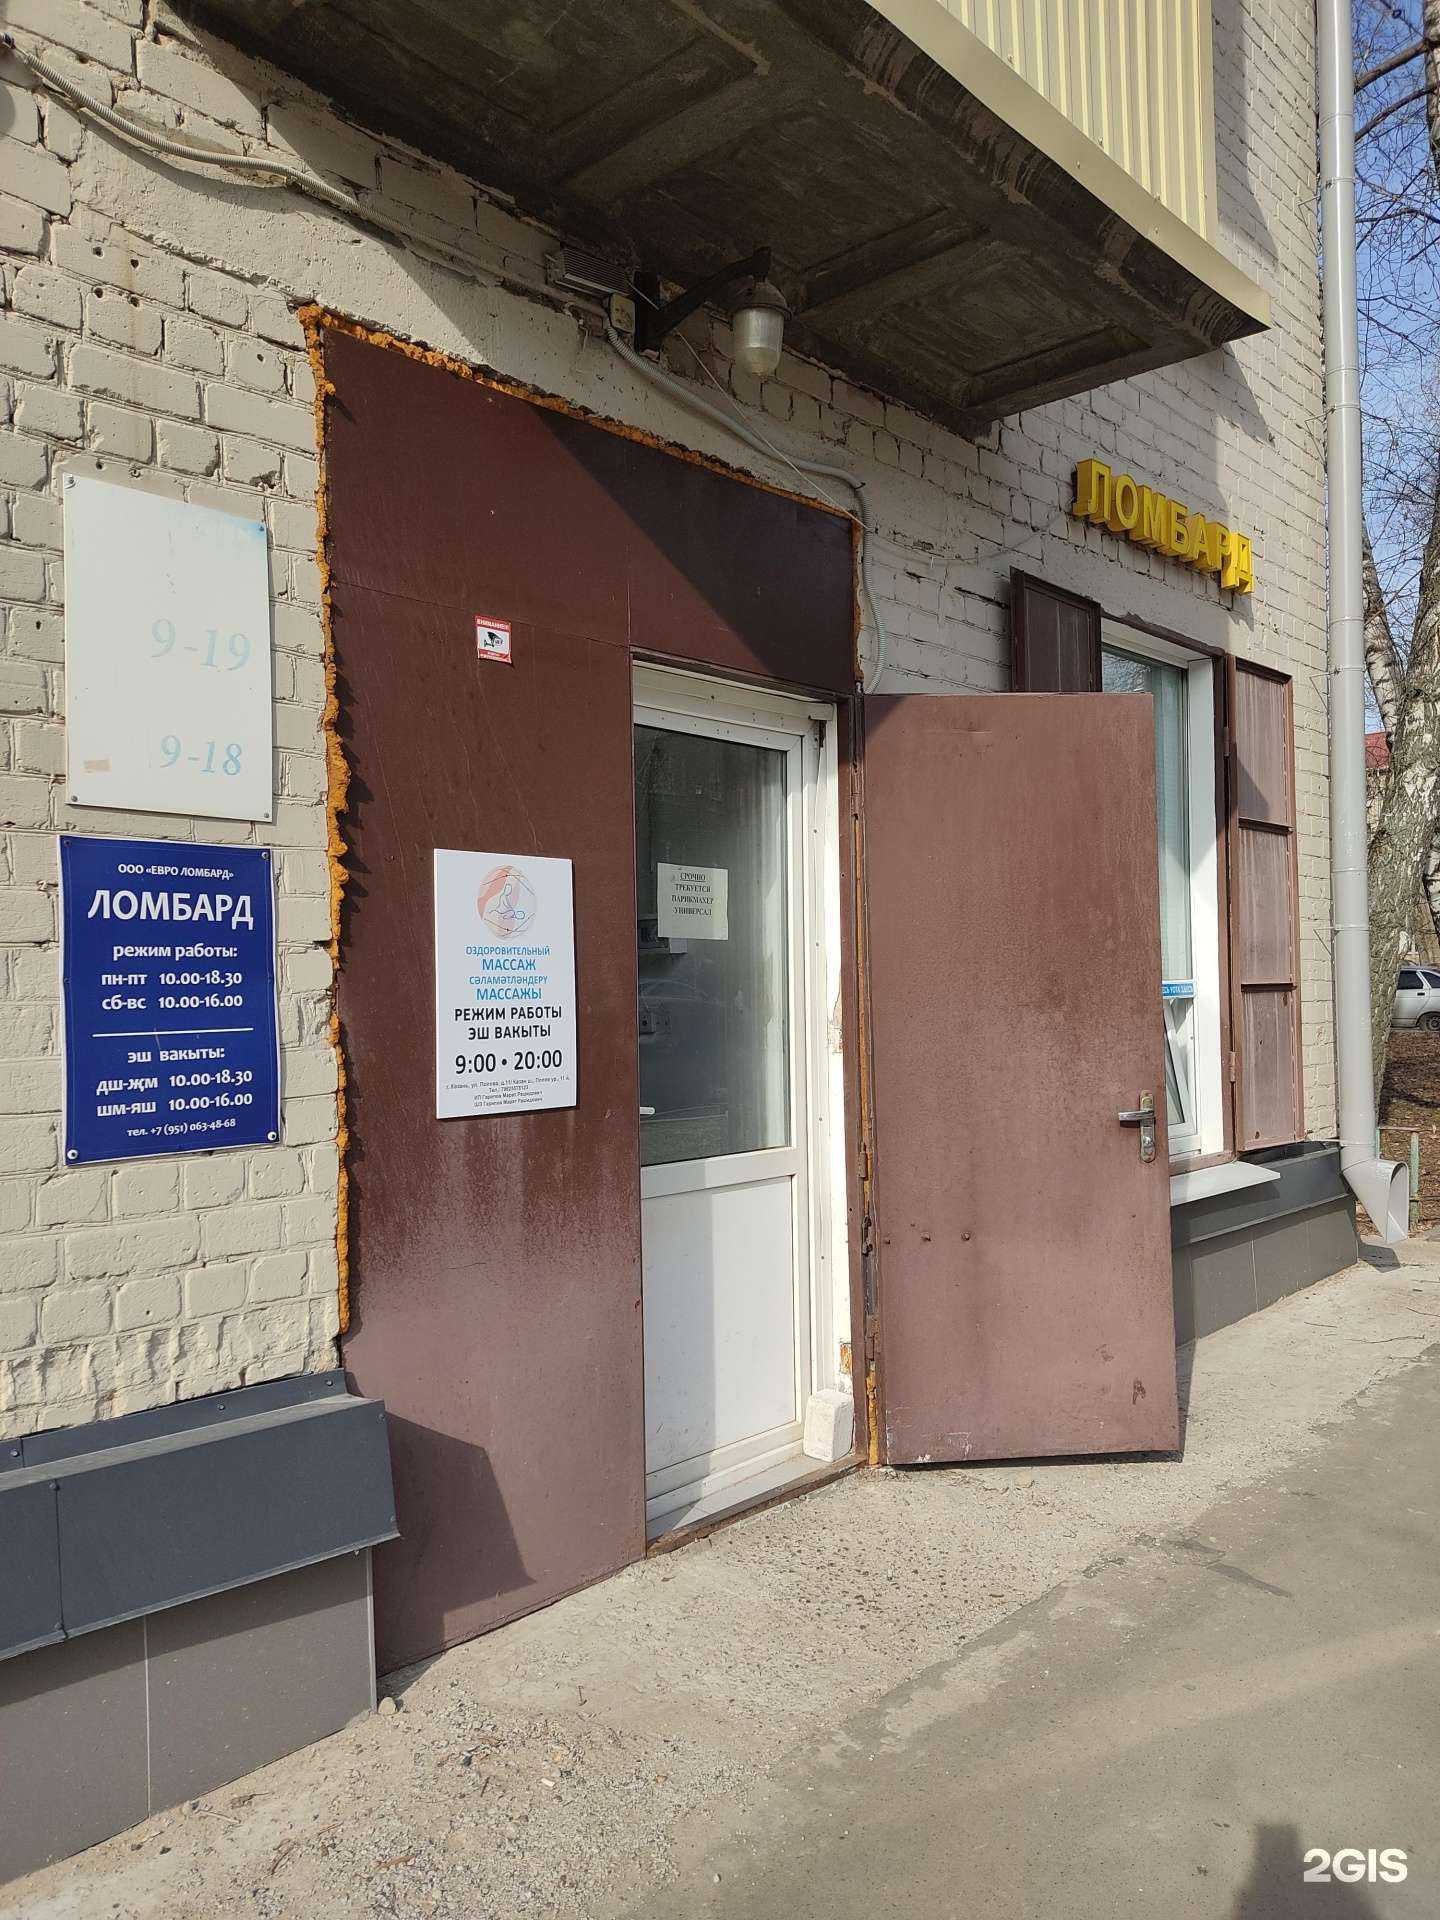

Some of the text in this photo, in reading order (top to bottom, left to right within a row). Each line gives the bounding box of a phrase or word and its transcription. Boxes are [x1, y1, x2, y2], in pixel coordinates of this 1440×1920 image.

[1073, 457, 1255, 595] ЛОМБАРД
[150, 618, 252, 672] 9-19
[160, 734, 243, 776] 9-18
[118, 863, 234, 880] ООО «ЕВРО ЛОМБАРД»
[88, 889, 254, 930] ЛОМБАРД
[113, 943, 238, 961] режим работы:
[465, 945, 550, 957] ОЗДОРОВИТЕЛЬНЫЙ
[482, 958, 536, 971] МАССАЖ
[101, 970, 242, 987] пн-пт 10.00-18.30
[102, 992, 243, 1010] сб-вс 10.00-16.00
[476, 987, 542, 1001] МАССАЖЫ
[454, 1005, 562, 1021] РЕЖИМ РАБОТЫ
[468, 1024, 551, 1041] ЭШ ВАКЫТЫ
[127, 1047, 225, 1063] эш вакыты:
[455, 1049, 563, 1074] 9:00 20:00
[169, 1069, 253, 1087] 10.00-18.30
[96, 1093, 253, 1117] шм-яш 10.00-16.00
[127, 1118, 236, 1137] тел. +7 (951) 063-48-68
